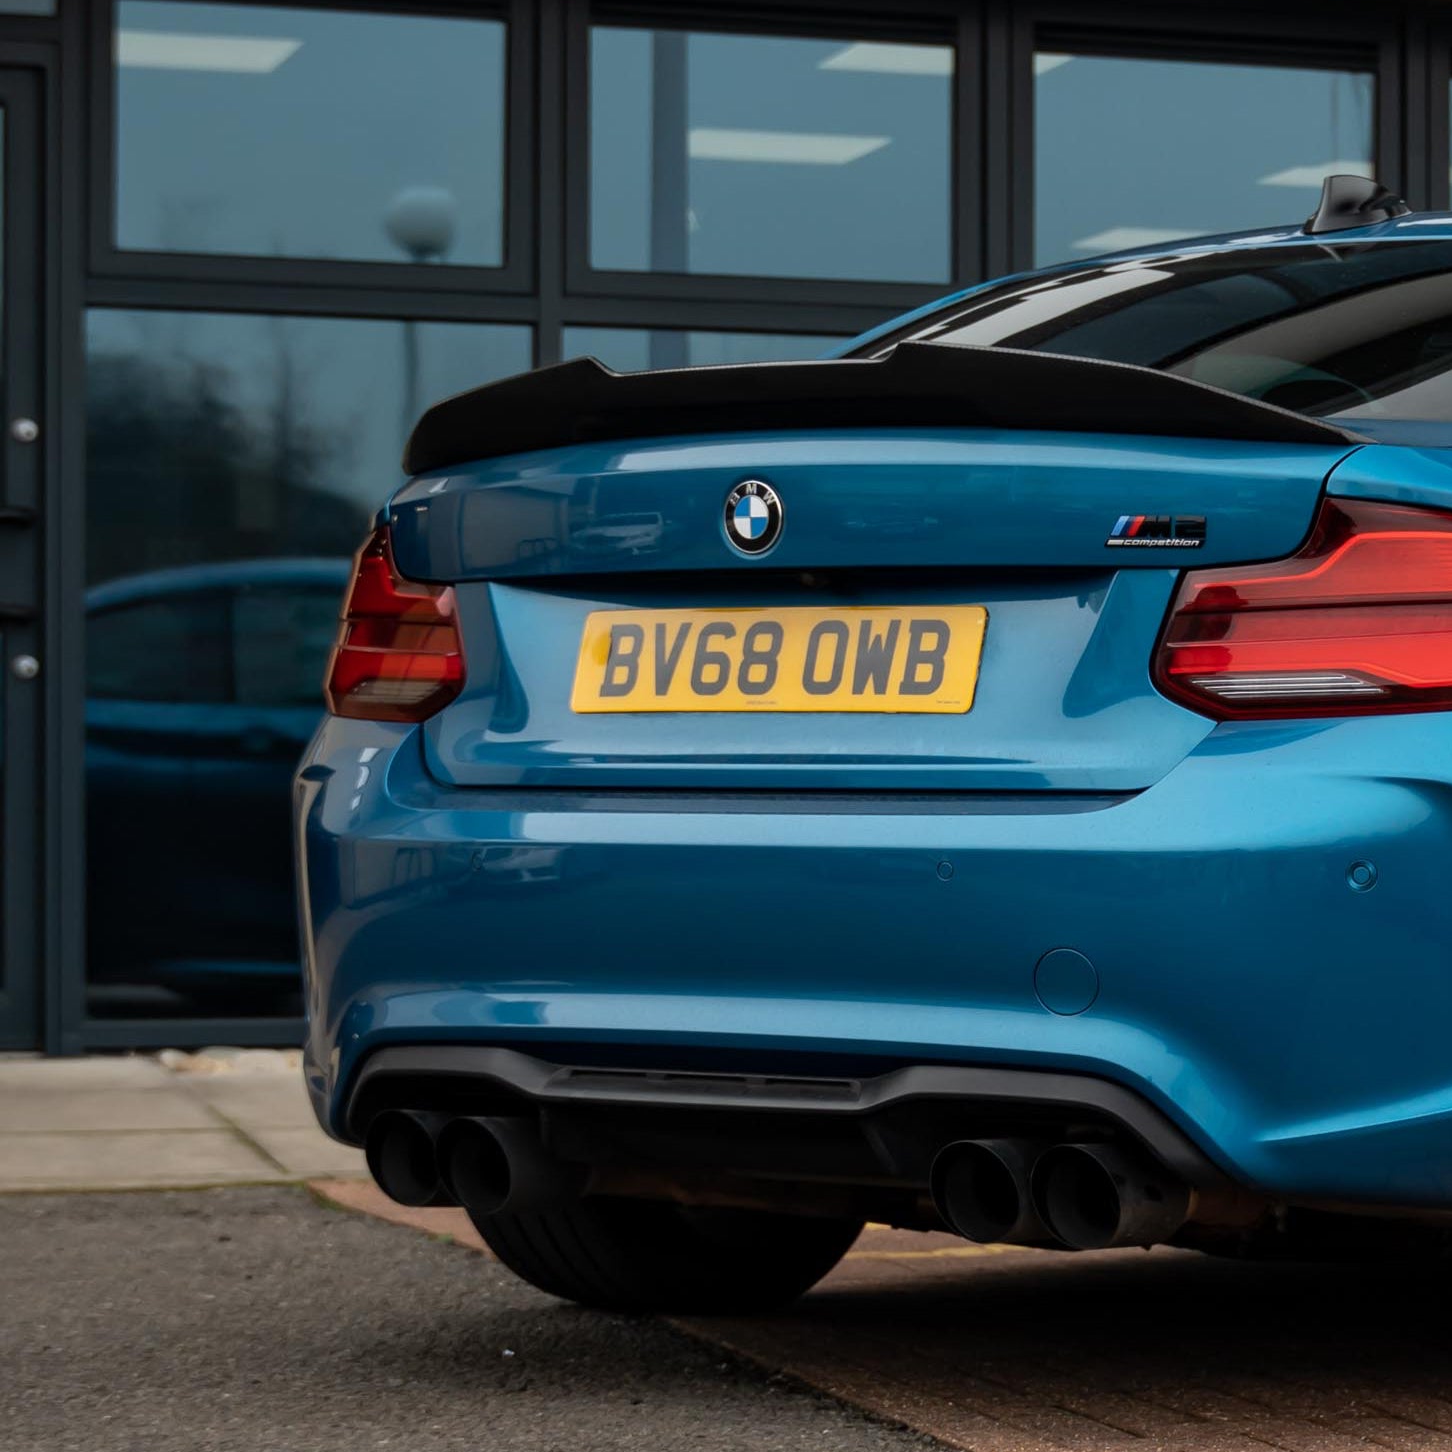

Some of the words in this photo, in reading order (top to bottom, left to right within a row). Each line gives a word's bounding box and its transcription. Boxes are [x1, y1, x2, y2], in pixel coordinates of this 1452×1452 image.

[729, 483, 777, 507] BMW
[1123, 538, 1200, 547] competition
[600, 620, 785, 697] BV68
[802, 619, 951, 696] OWB
